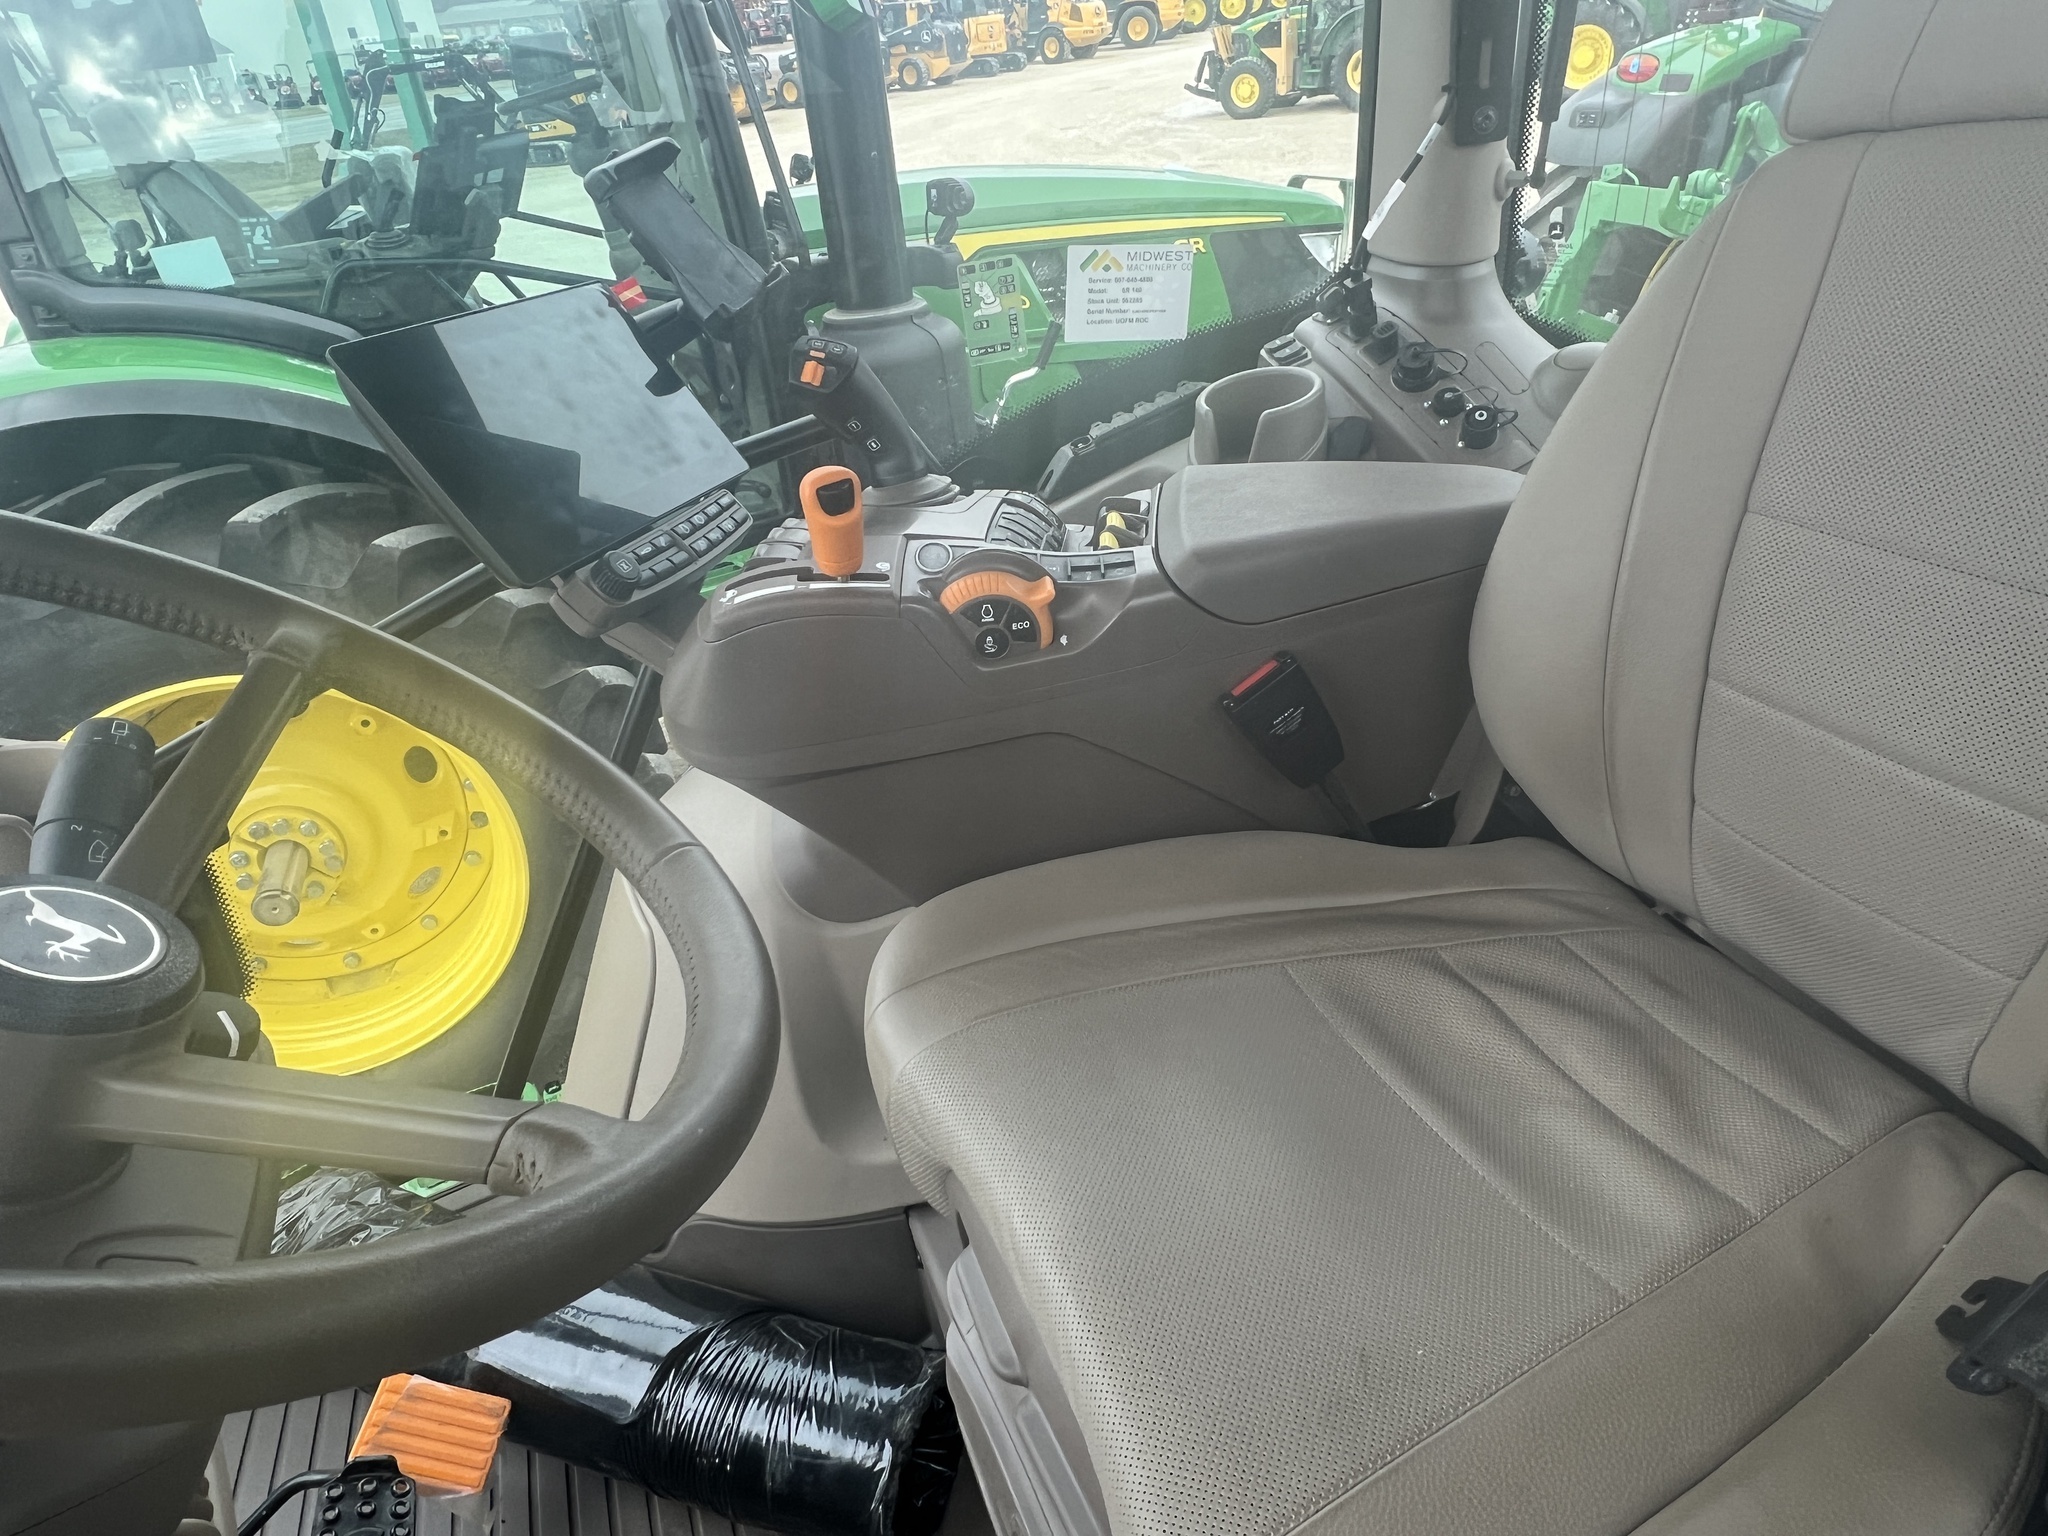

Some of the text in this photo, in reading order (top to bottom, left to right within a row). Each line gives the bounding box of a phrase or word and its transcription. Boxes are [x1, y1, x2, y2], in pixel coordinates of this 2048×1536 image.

[1126, 250, 1193, 262] MIDWEST
[1126, 262, 1177, 272] MACHINERY
[1086, 317, 1114, 325] Location:
[1012, 620, 1030, 630] ECO
